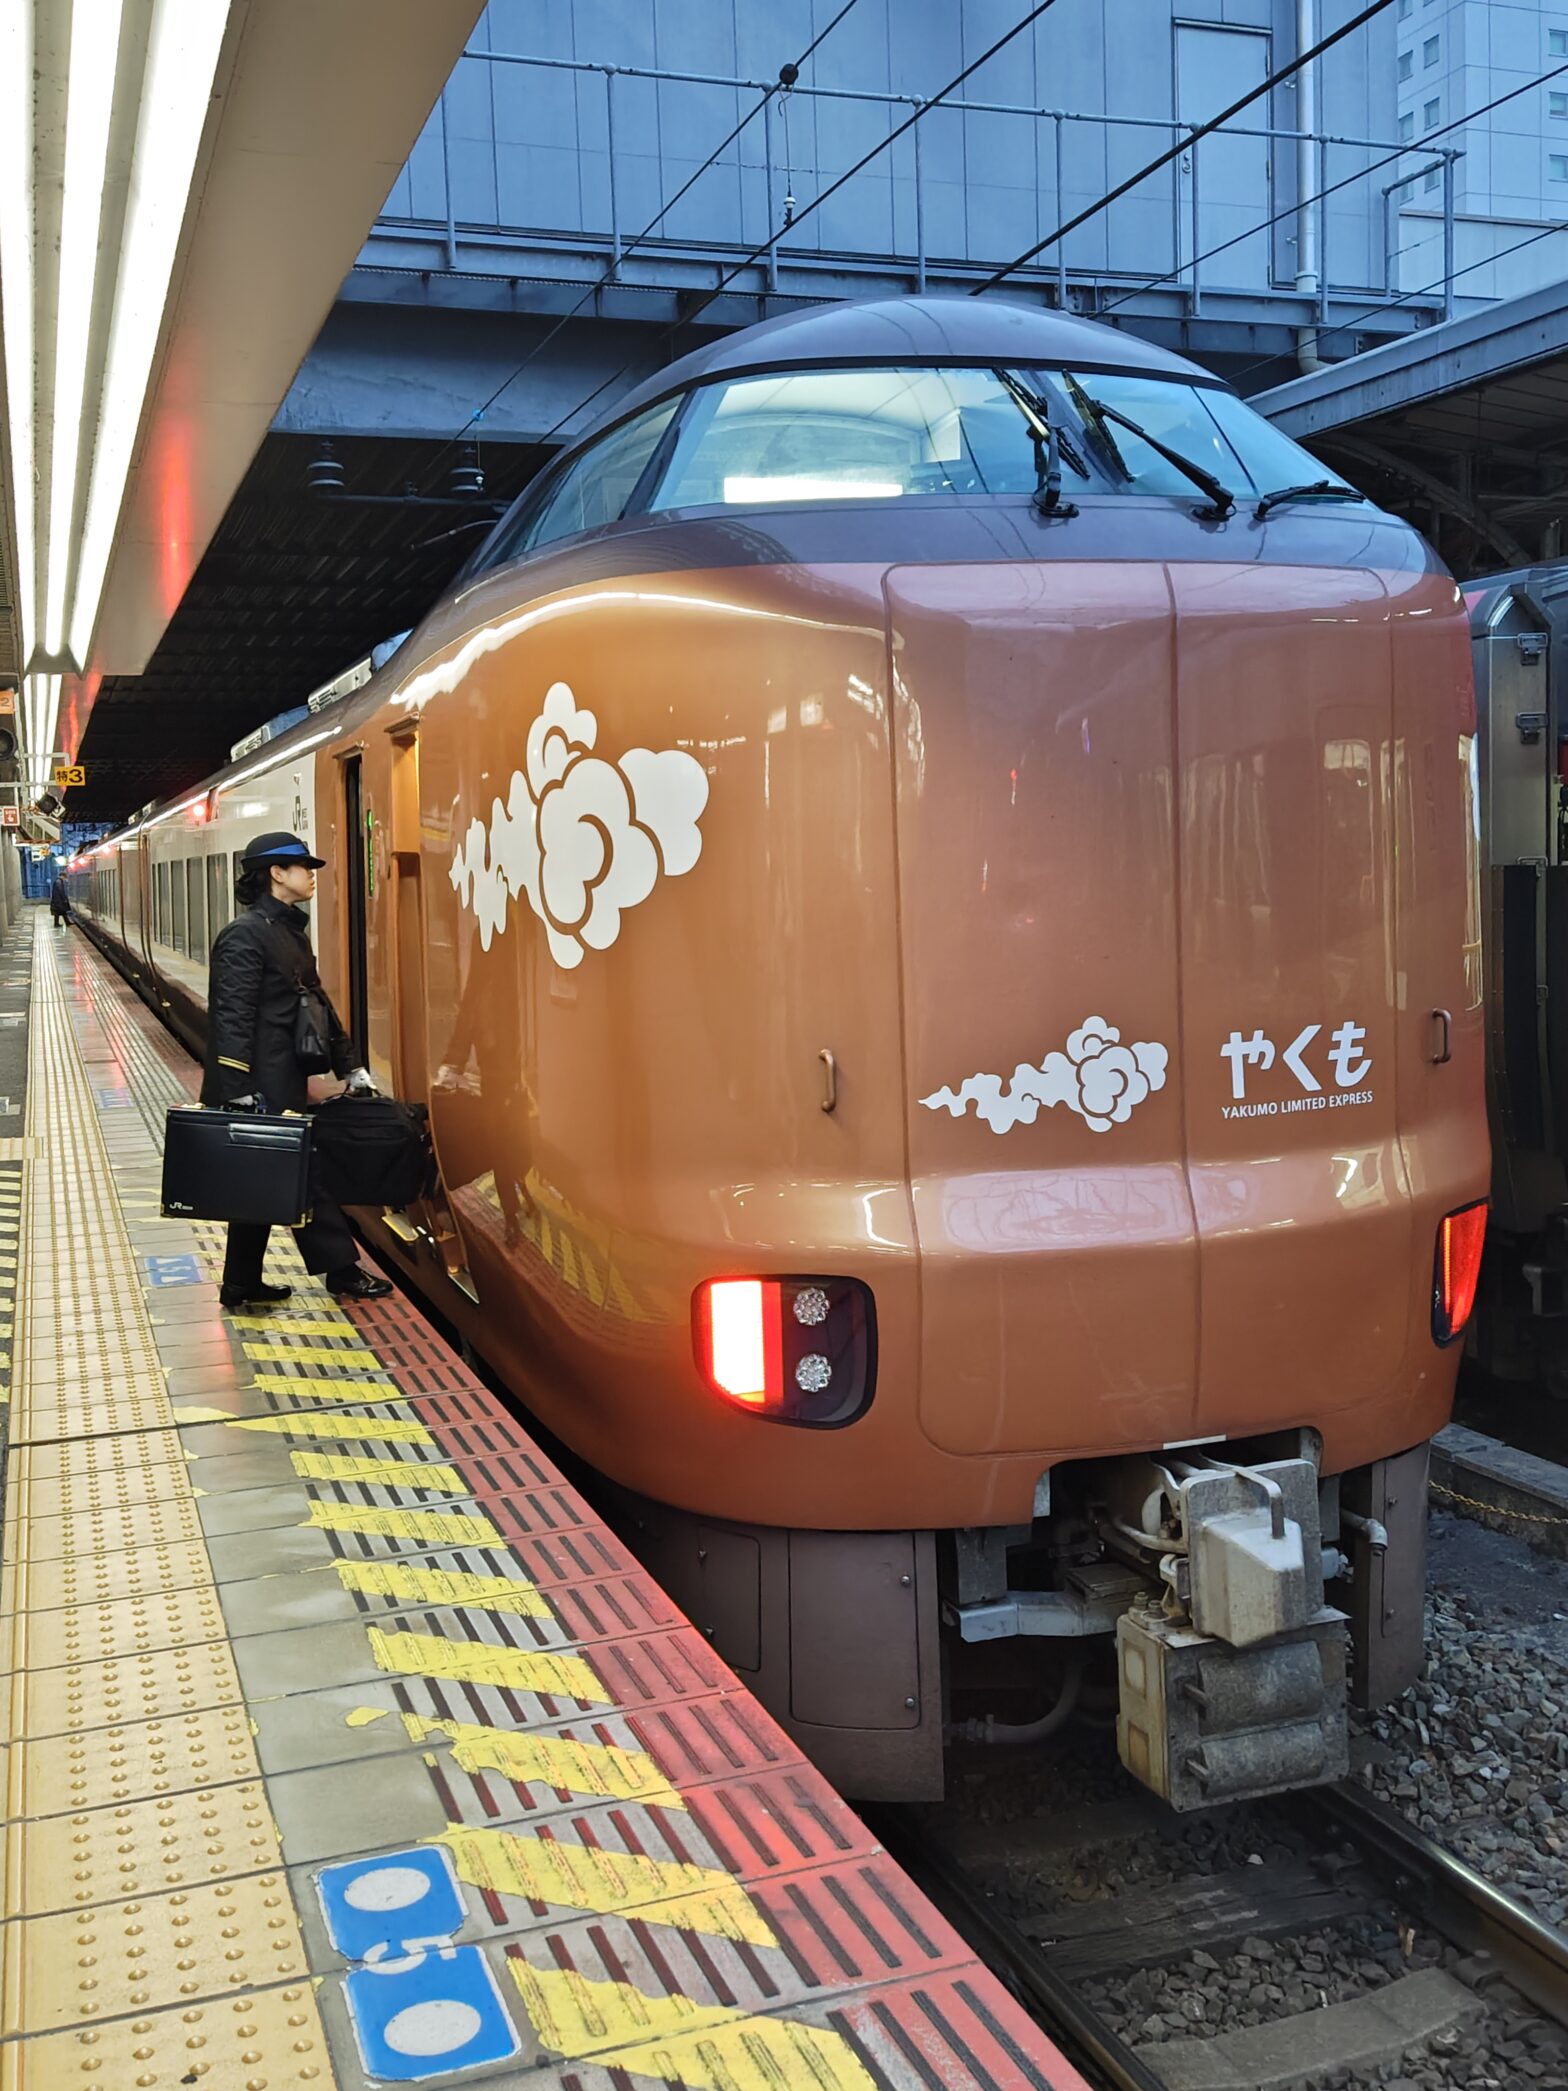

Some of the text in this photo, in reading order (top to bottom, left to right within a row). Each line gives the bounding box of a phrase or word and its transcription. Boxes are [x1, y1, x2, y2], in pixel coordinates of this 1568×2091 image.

[1220, 1021, 1373, 1099] やくも
[1222, 1090, 1373, 1119] YAKUMO LIMITED EXPRESS
